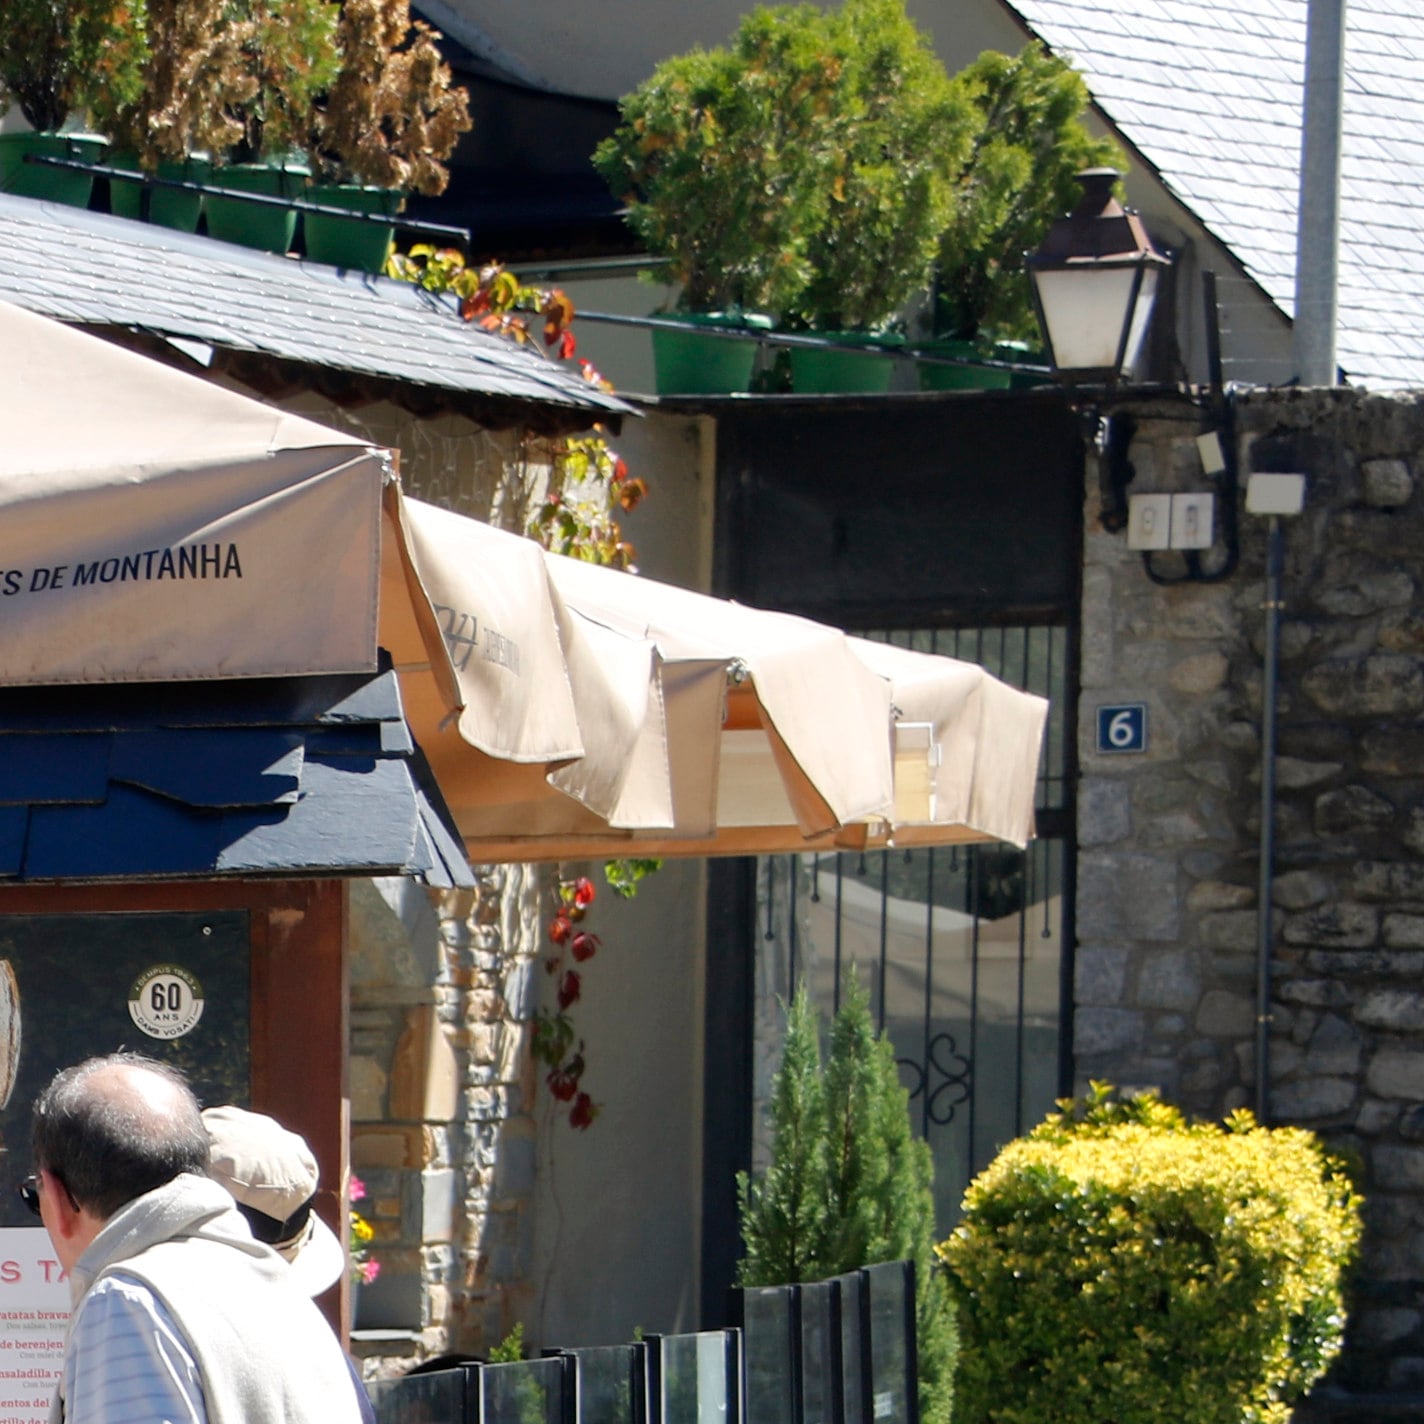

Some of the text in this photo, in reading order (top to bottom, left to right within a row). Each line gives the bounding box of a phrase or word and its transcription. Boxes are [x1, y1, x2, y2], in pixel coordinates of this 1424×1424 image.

[30, 564, 67, 596] DE
[73, 541, 243, 590] MONTANHA
[1107, 710, 1134, 748] 6
[152, 982, 180, 1011] 60
[0, 1340, 12, 1349] de
[15, 1340, 63, 1351] berenjen
[33, 1399, 50, 1408] del
